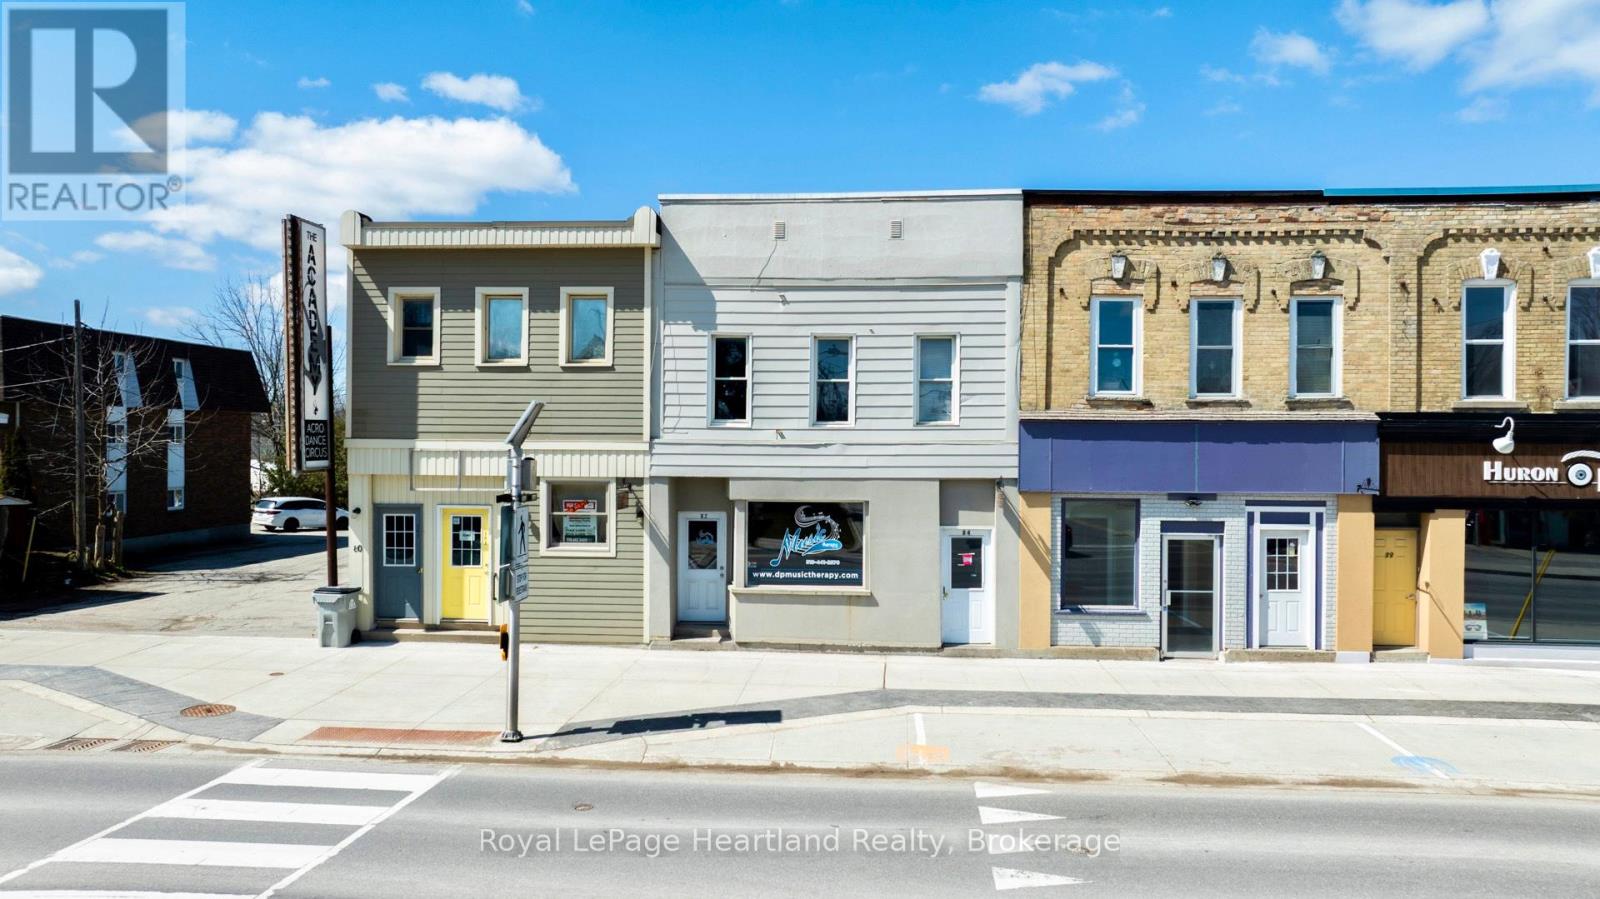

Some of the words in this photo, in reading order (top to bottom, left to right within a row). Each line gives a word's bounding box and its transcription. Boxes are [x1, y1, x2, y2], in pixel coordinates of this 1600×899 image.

[306, 231, 318, 242] THE
[306, 423, 325, 433] ACRO
[305, 435, 327, 446] DANCE
[305, 447, 328, 458] CIRCUS
[752, 570, 859, 579] www.dpmusictherapy.com
